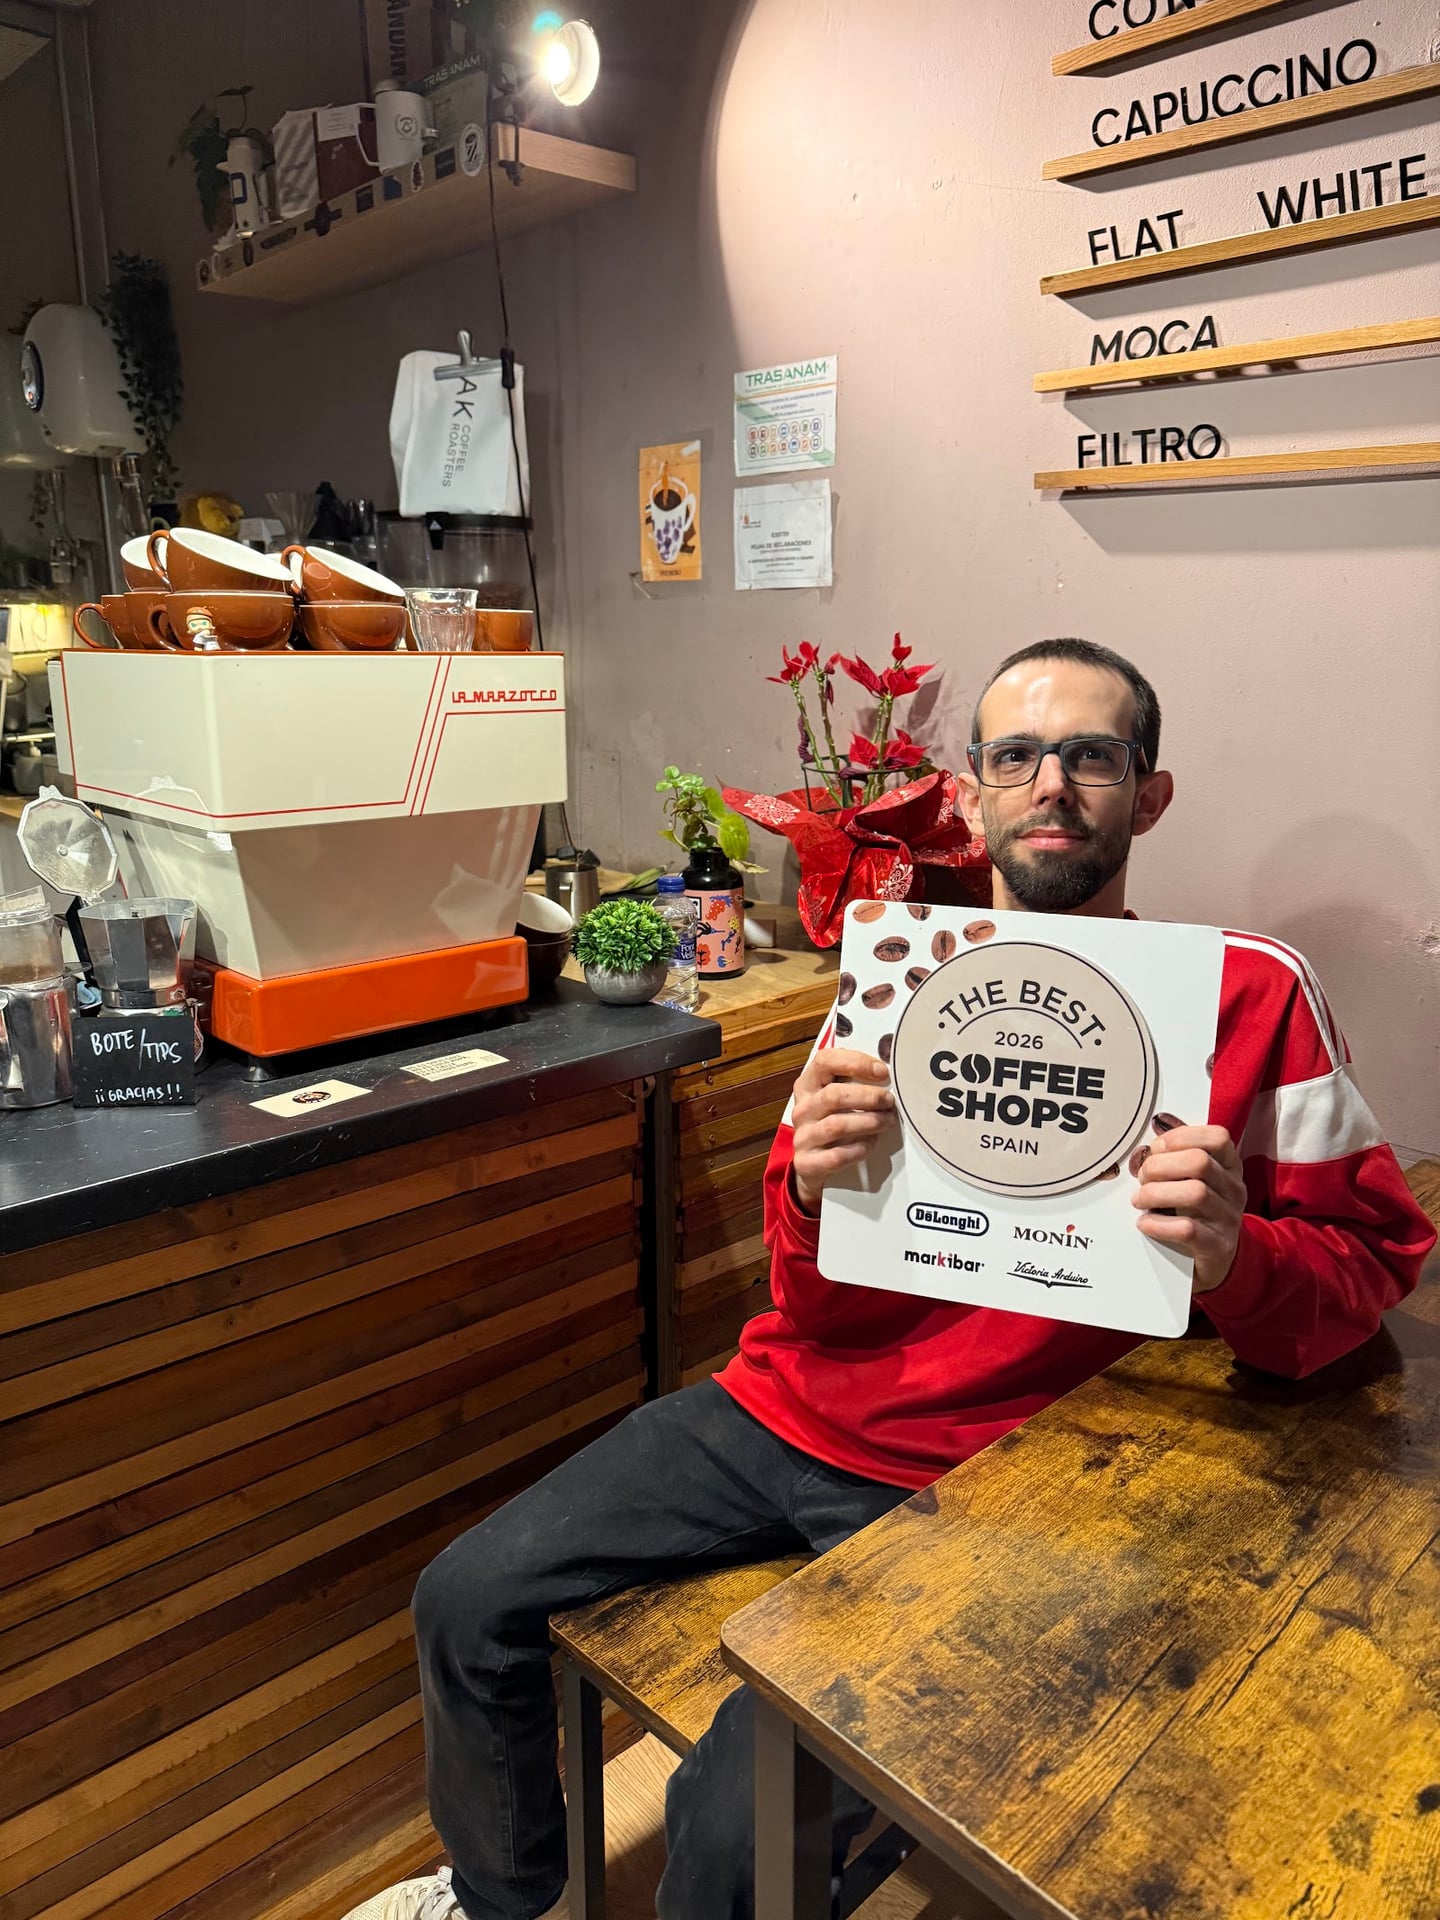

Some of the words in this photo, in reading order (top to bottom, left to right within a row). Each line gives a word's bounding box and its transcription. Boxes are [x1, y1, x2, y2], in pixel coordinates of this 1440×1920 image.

[1091, 38, 1378, 148] CAPUCCINO
[1087, 209, 1184, 266] FLAT
[1257, 153, 1428, 229] WHITE
[1090, 315, 1218, 366] MOCA
[745, 361, 827, 387] TRASANAM
[442, 423, 460, 488] ROASTERS
[455, 424, 471, 472] COFFEE
[1077, 424, 1222, 469] FILTRO
[452, 691, 466, 703] LA
[473, 690, 557, 703] MARZOCCO
[938, 979, 1007, 1024] THE
[1019, 979, 1106, 1037] BEST
[994, 1031, 1044, 1050] 2026
[929, 1050, 1106, 1100] COFFEE
[936, 1086, 1089, 1134] SHOPS
[980, 1134, 1039, 1156] SPAIN
[904, 1249, 981, 1273] markibar
[1013, 1260, 1049, 1278] Victoria
[1051, 1268, 1089, 1285] Arduino
